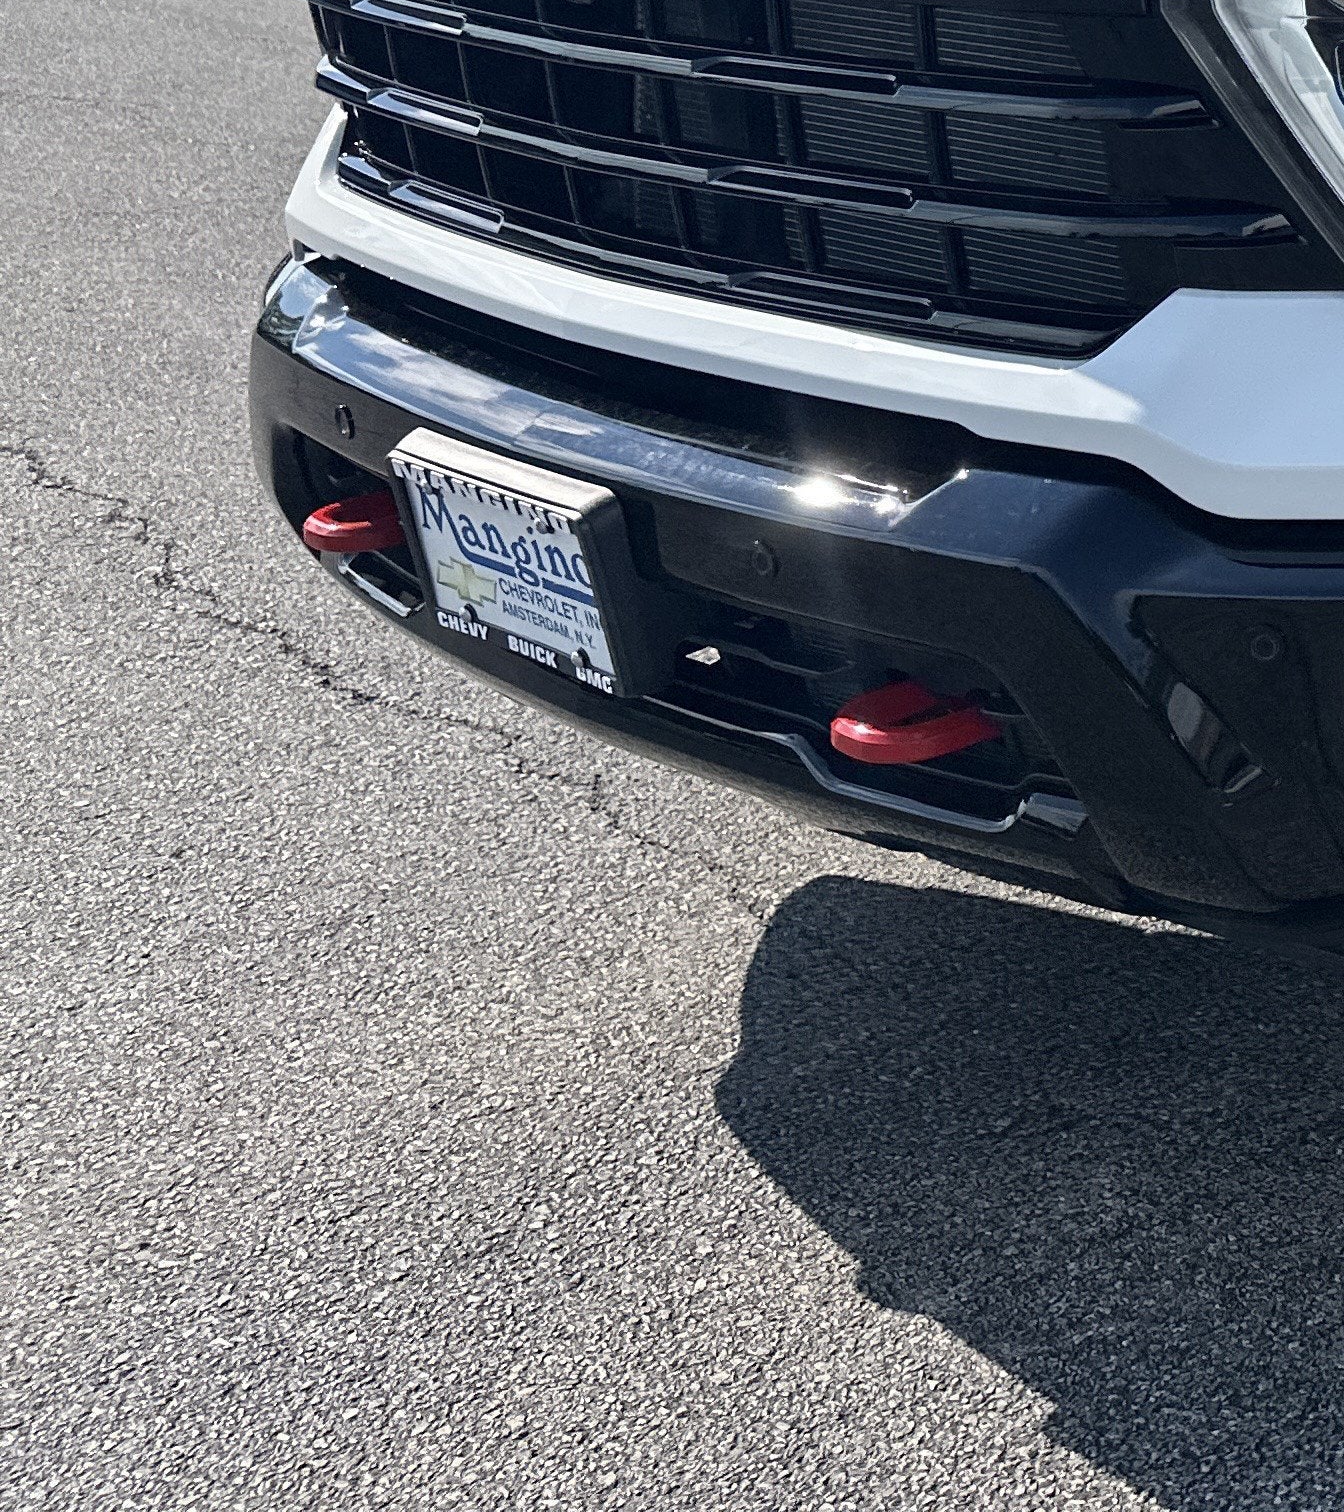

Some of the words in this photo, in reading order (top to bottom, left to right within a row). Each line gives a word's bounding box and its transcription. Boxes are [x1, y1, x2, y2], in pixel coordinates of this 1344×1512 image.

[437, 610, 489, 641] CHEVY
[507, 634, 559, 670] BUICK
[575, 666, 614, 695] GMC
